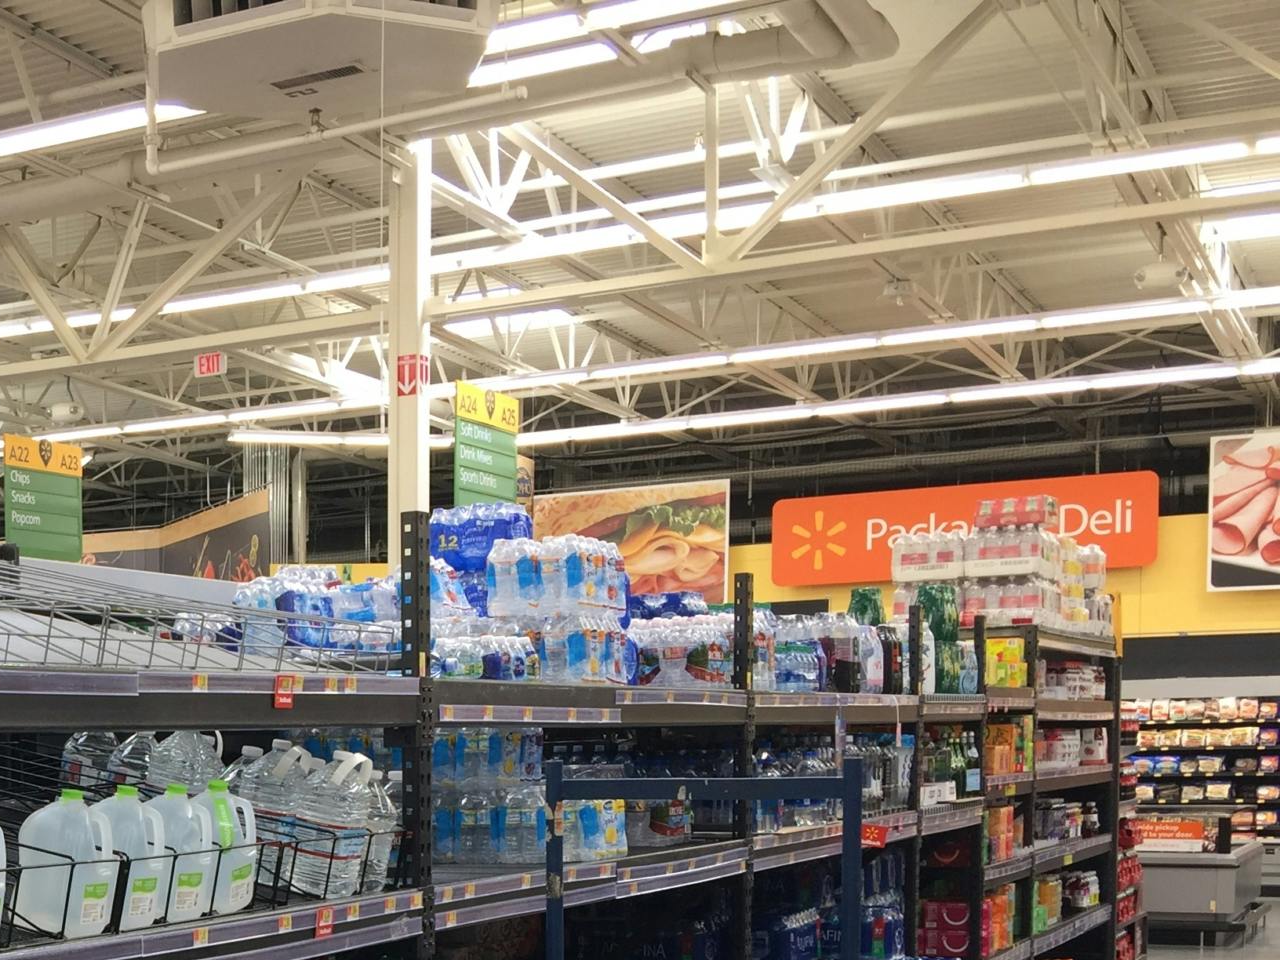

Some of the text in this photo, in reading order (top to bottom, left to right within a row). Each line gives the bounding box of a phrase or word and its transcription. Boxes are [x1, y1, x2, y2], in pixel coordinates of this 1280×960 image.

[198, 353, 220, 374] EXIT
[460, 395, 516, 426] A24 A25
[461, 421, 492, 443] Soft Drinks
[8, 445, 79, 471] A22 A23
[460, 445, 476, 460] Drink
[10, 469, 31, 485] Chips
[460, 467, 479, 485] Sports
[480, 472, 497, 488] Drinks
[11, 490, 36, 505] Snacks
[11, 510, 41, 526] Popcorn
[1059, 498, 1133, 537] Deli
[438, 534, 458, 548] 12
